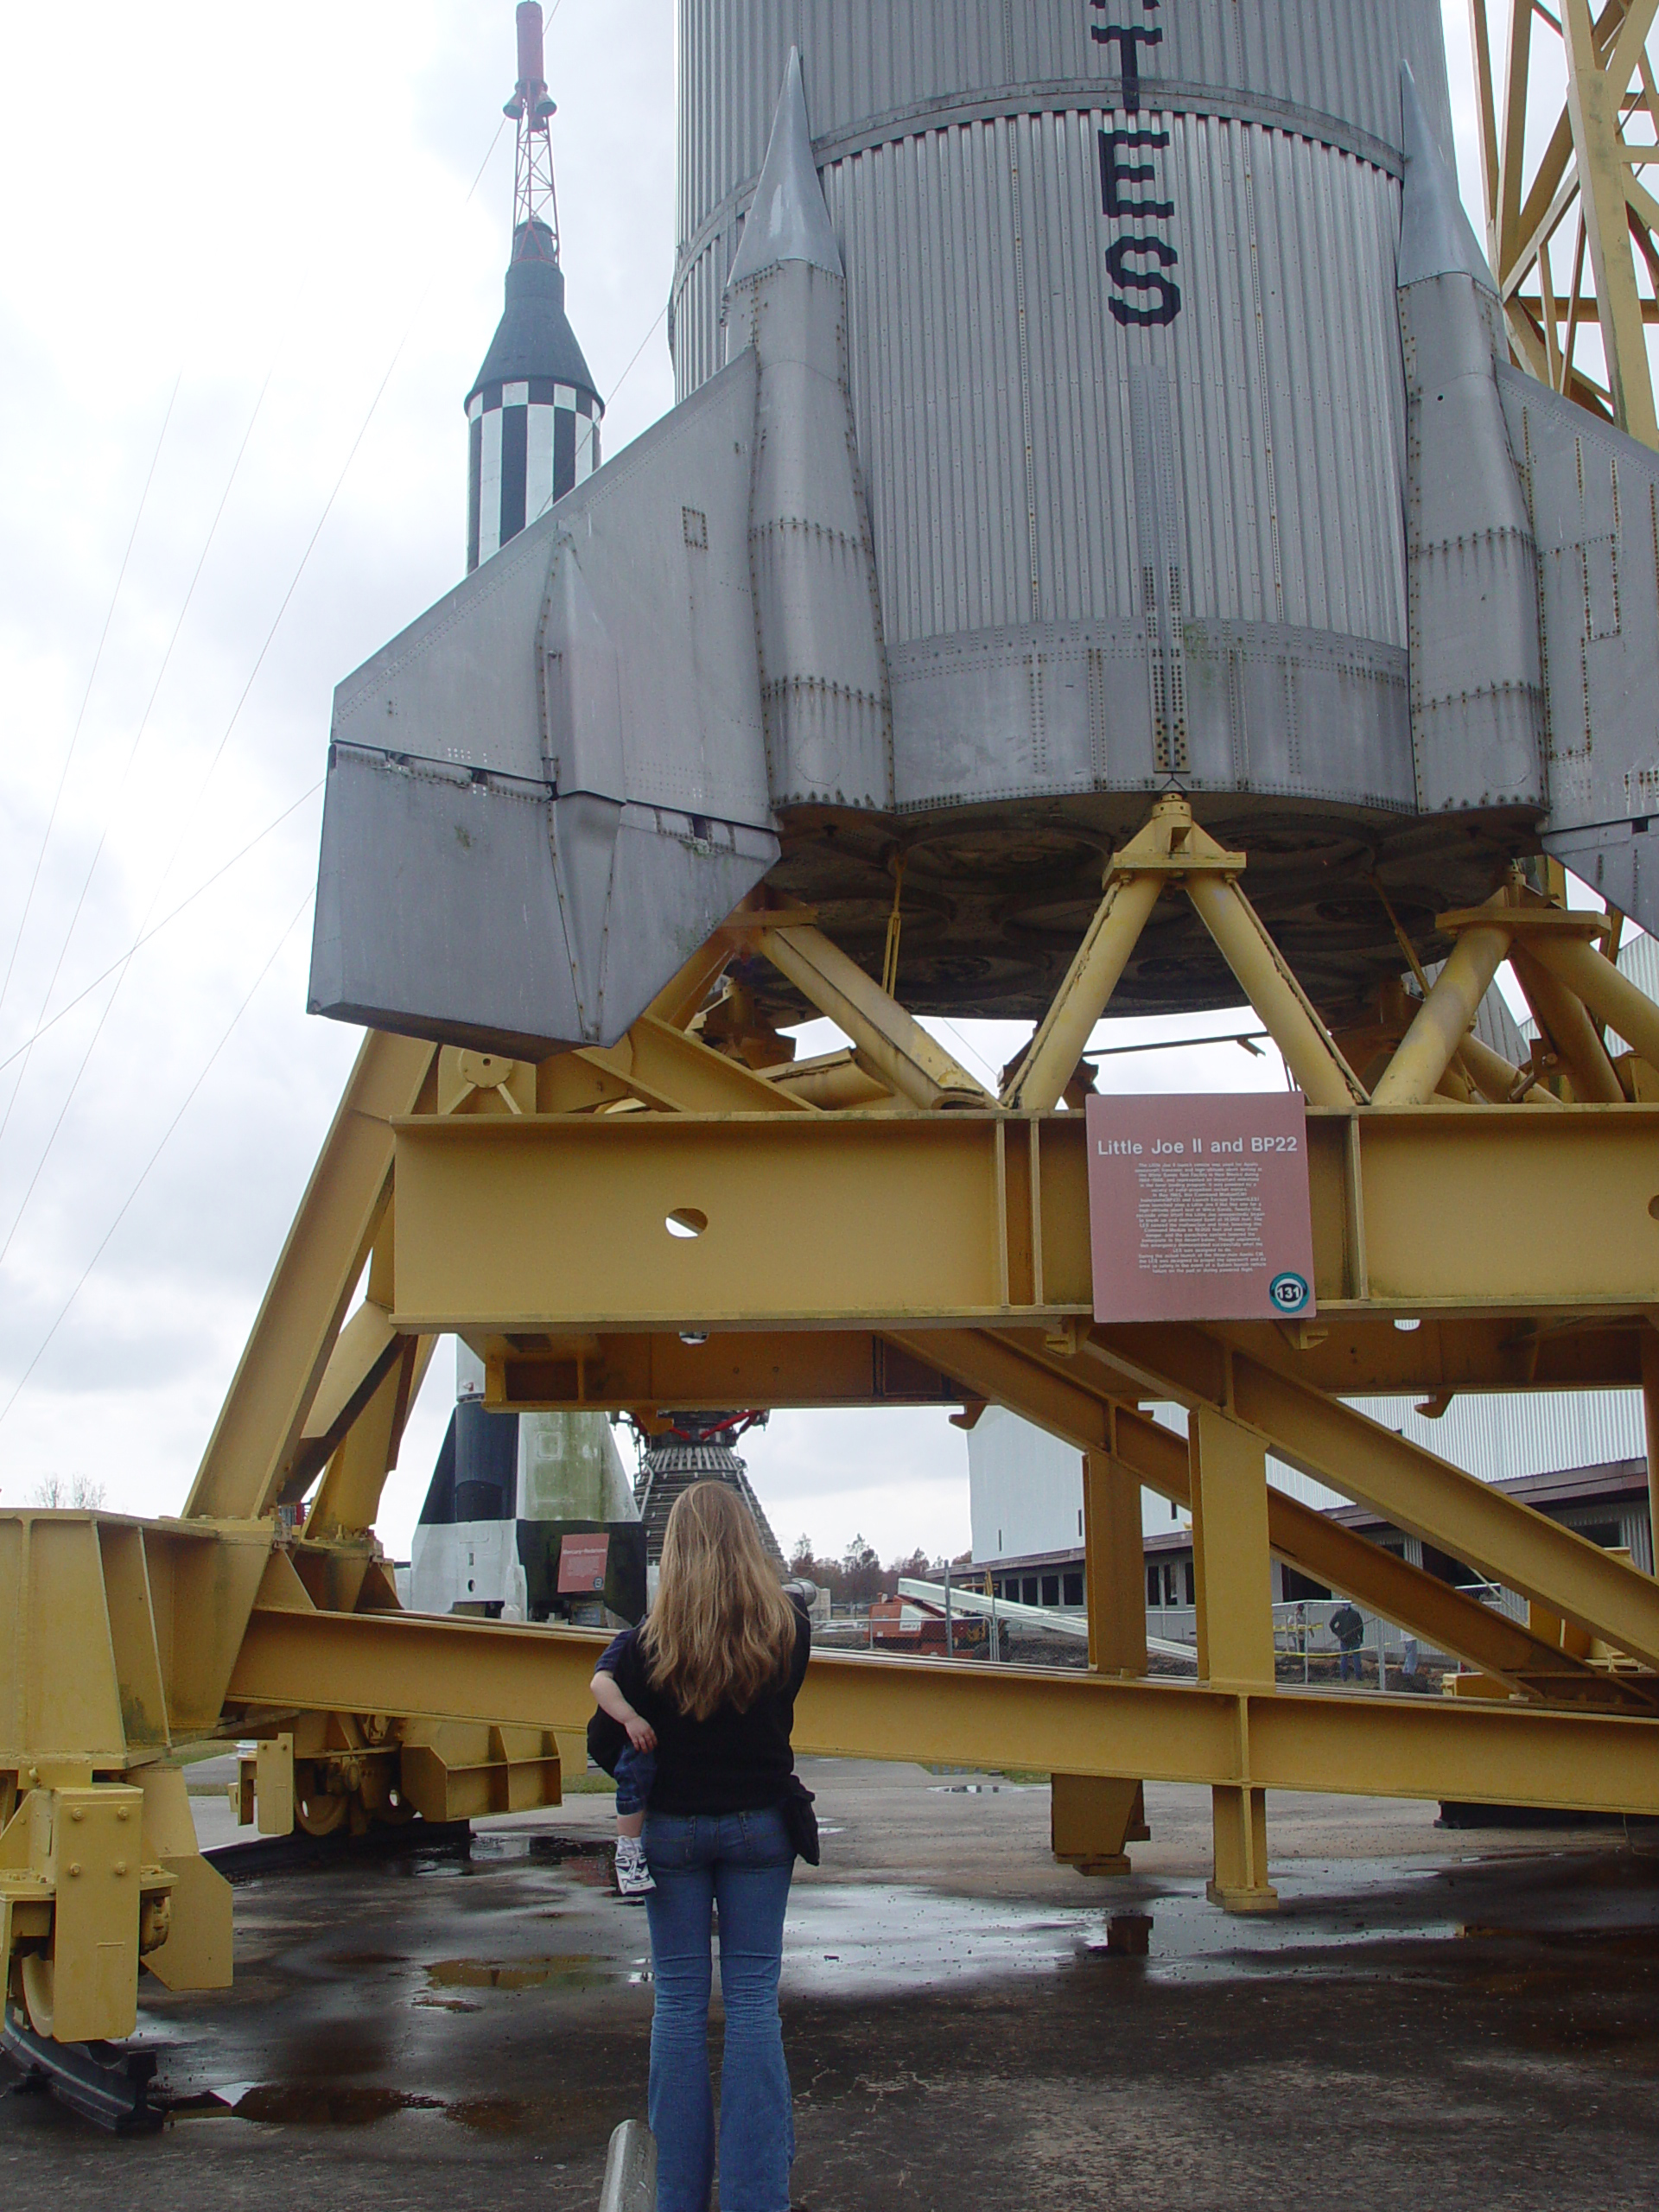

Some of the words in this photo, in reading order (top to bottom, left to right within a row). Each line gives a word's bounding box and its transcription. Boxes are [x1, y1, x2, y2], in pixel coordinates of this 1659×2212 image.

[1089, 0, 1181, 327] TES
[1097, 1140, 1143, 1155] Little
[1151, 1138, 1185, 1154] Joe
[1192, 1138, 1202, 1154] II
[1211, 1137, 1243, 1154] and
[1251, 1136, 1298, 1153] BP22
[1277, 1287, 1300, 1299] 131
